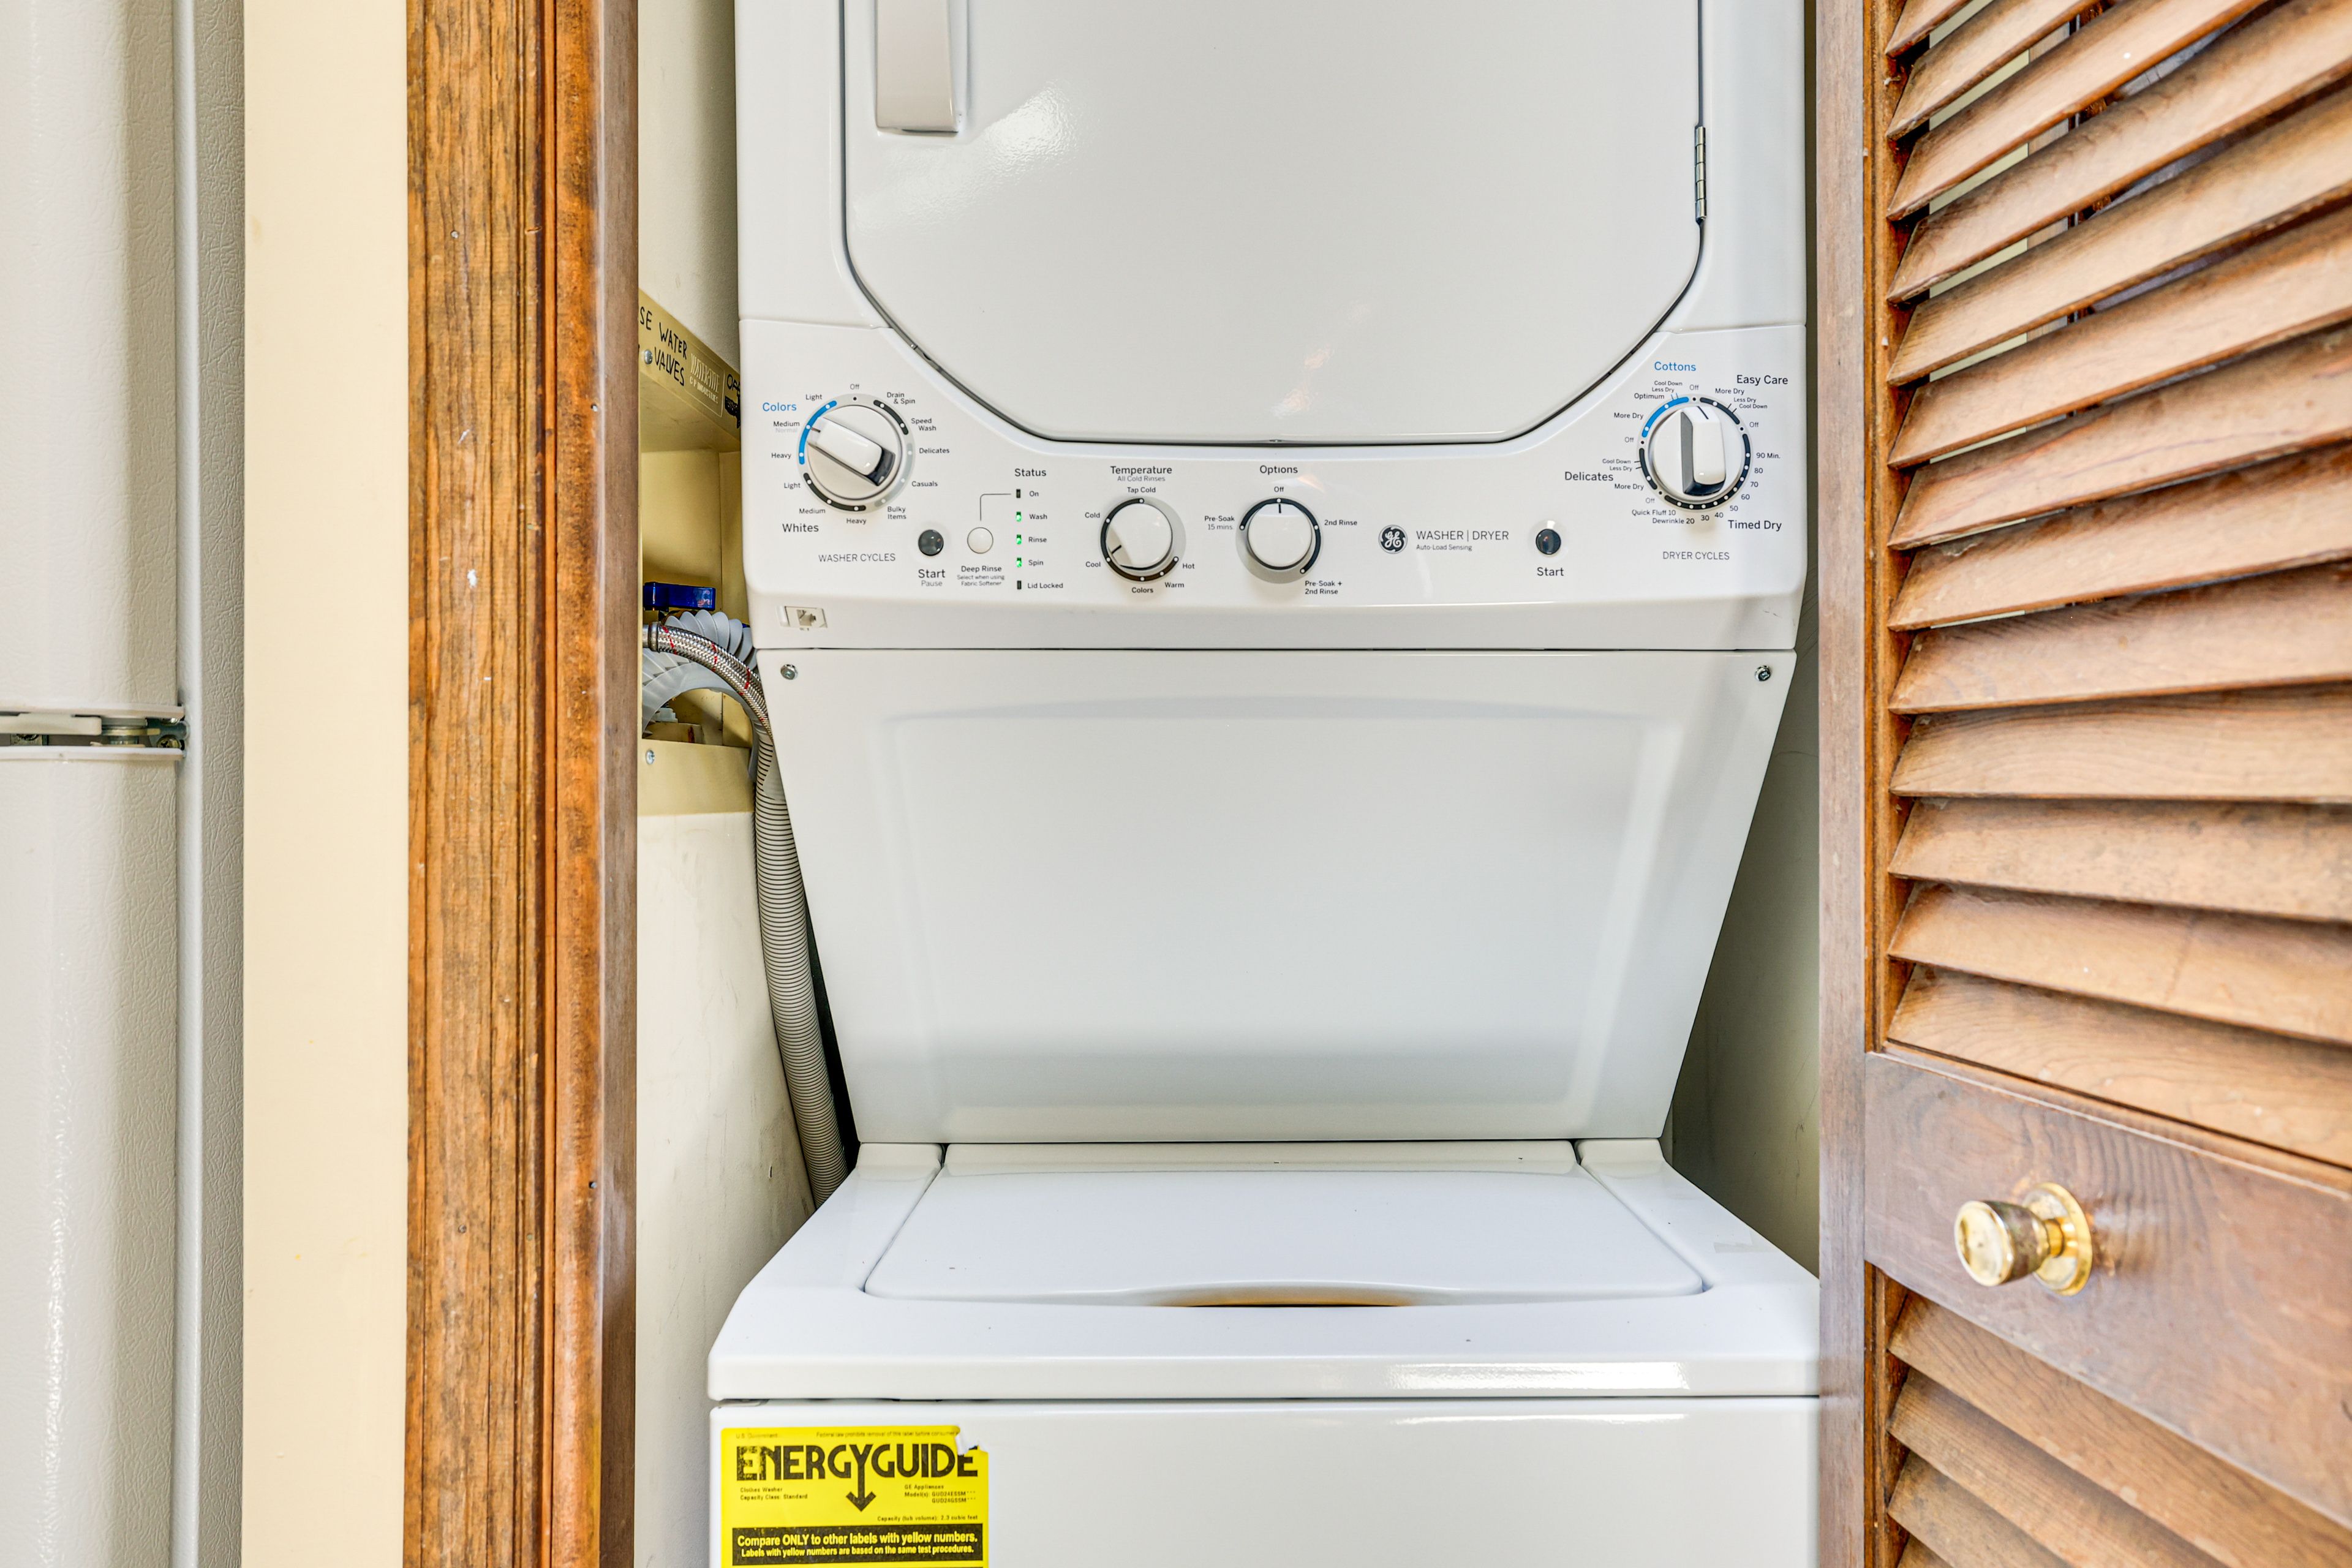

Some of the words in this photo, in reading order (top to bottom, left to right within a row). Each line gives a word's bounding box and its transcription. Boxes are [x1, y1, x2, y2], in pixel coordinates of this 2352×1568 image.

[659, 322, 687, 360] WATER
[654, 347, 684, 386] VALVES
[1654, 362, 1696, 371] Cottons
[1736, 375, 1760, 386] Easy
[1764, 375, 1788, 385] Care
[763, 402, 797, 412] Colors
[1014, 468, 1047, 477] Status
[1110, 466, 1172, 476] Temperature
[1260, 465, 1298, 475] Options
[1564, 472, 1613, 481] Delicates
[782, 523, 819, 532] Whites
[1728, 520, 1760, 530] Timed
[1763, 521, 1782, 531] Dry
[1416, 530, 1463, 540] WASHER
[1472, 530, 1509, 540] DRYER
[818, 554, 858, 562] WASHER
[860, 553, 895, 562] CYCLES
[1695, 552, 1730, 560] CYCLES
[918, 570, 945, 578] Start
[1537, 567, 1564, 576] Start
[737, 1443, 978, 1481] ENERGYGUIDE
[737, 1535, 780, 1548] Compare
[782, 1534, 809, 1545] ONLY
[811, 1534, 821, 1545] to
[823, 1533, 848, 1545] other
[850, 1532, 878, 1544] labels
[880, 1532, 900, 1544] with
[902, 1531, 932, 1545] yellow
[933, 1531, 978, 1543] numbers.
[741, 1548, 764, 1558] Labels
[766, 1548, 781, 1556] with
[783, 1547, 805, 1558] yellow
[807, 1547, 837, 1556] numbers
[851, 1545, 873, 1555] based
[885, 1545, 896, 1555] the
[932, 1544, 974, 1555] procedures.
